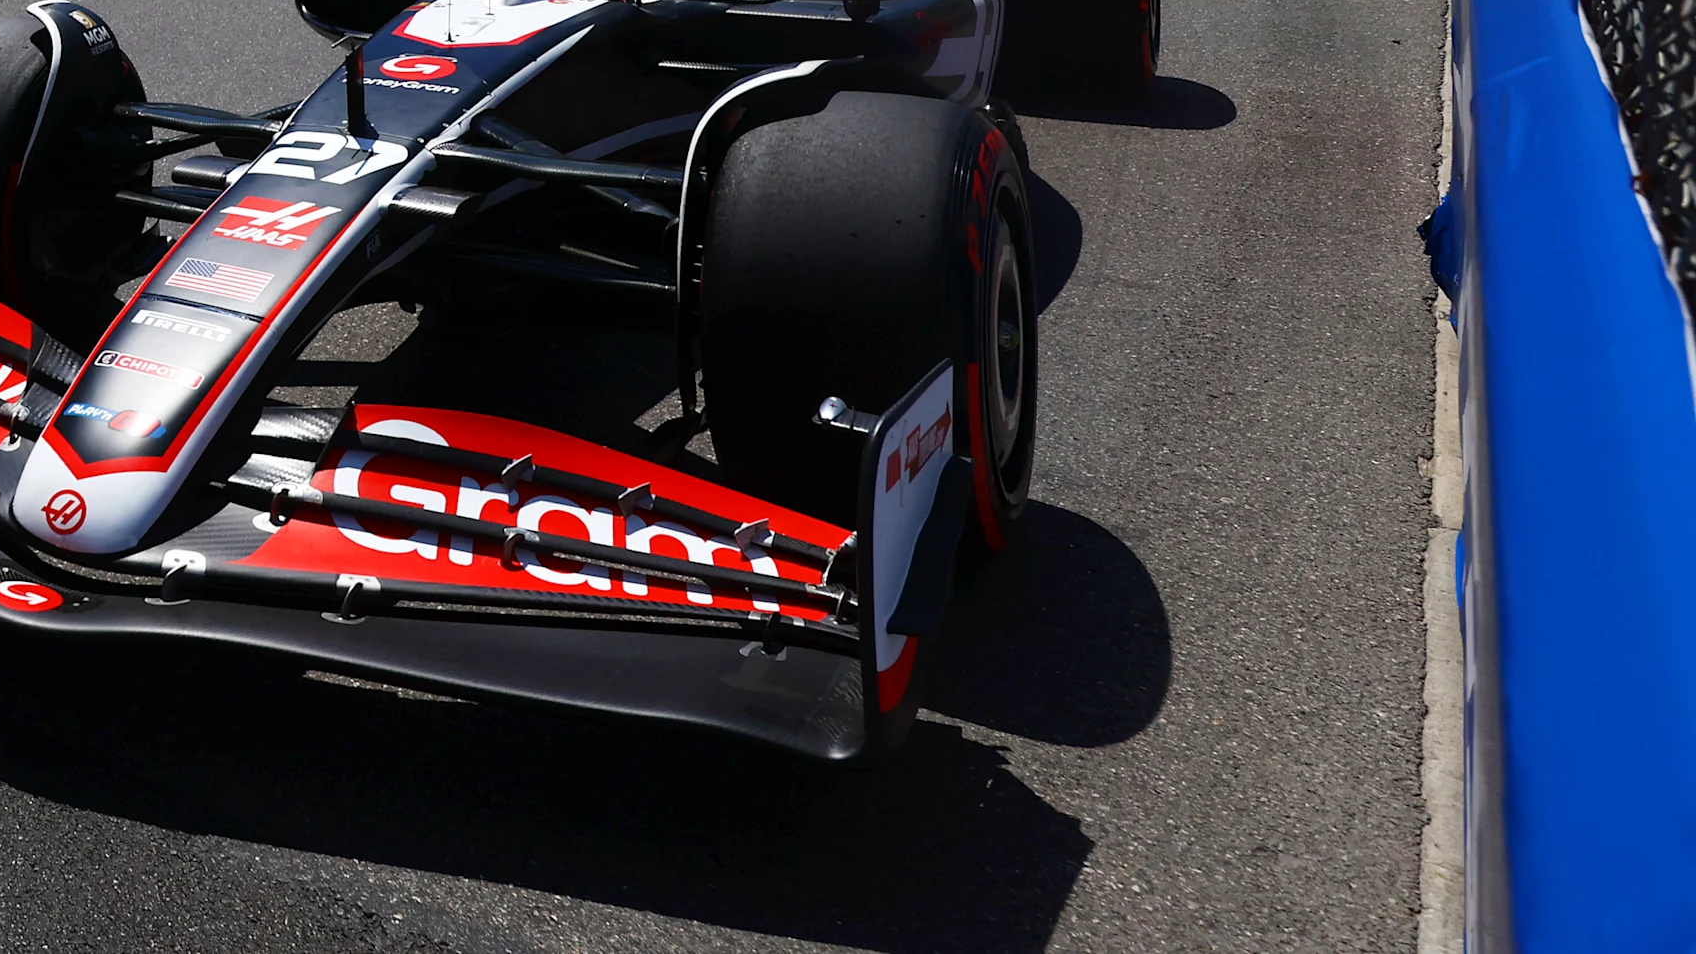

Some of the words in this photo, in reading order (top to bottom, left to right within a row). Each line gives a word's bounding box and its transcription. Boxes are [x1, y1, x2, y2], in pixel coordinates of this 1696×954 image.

[82, 25, 112, 47] MGM
[340, 74, 460, 95] oneyGram
[247, 130, 409, 186] 27
[214, 225, 307, 247] HAAS
[131, 309, 232, 343] PIRELLI
[118, 356, 196, 385] CHIPOT
[332, 419, 780, 612] Gram
